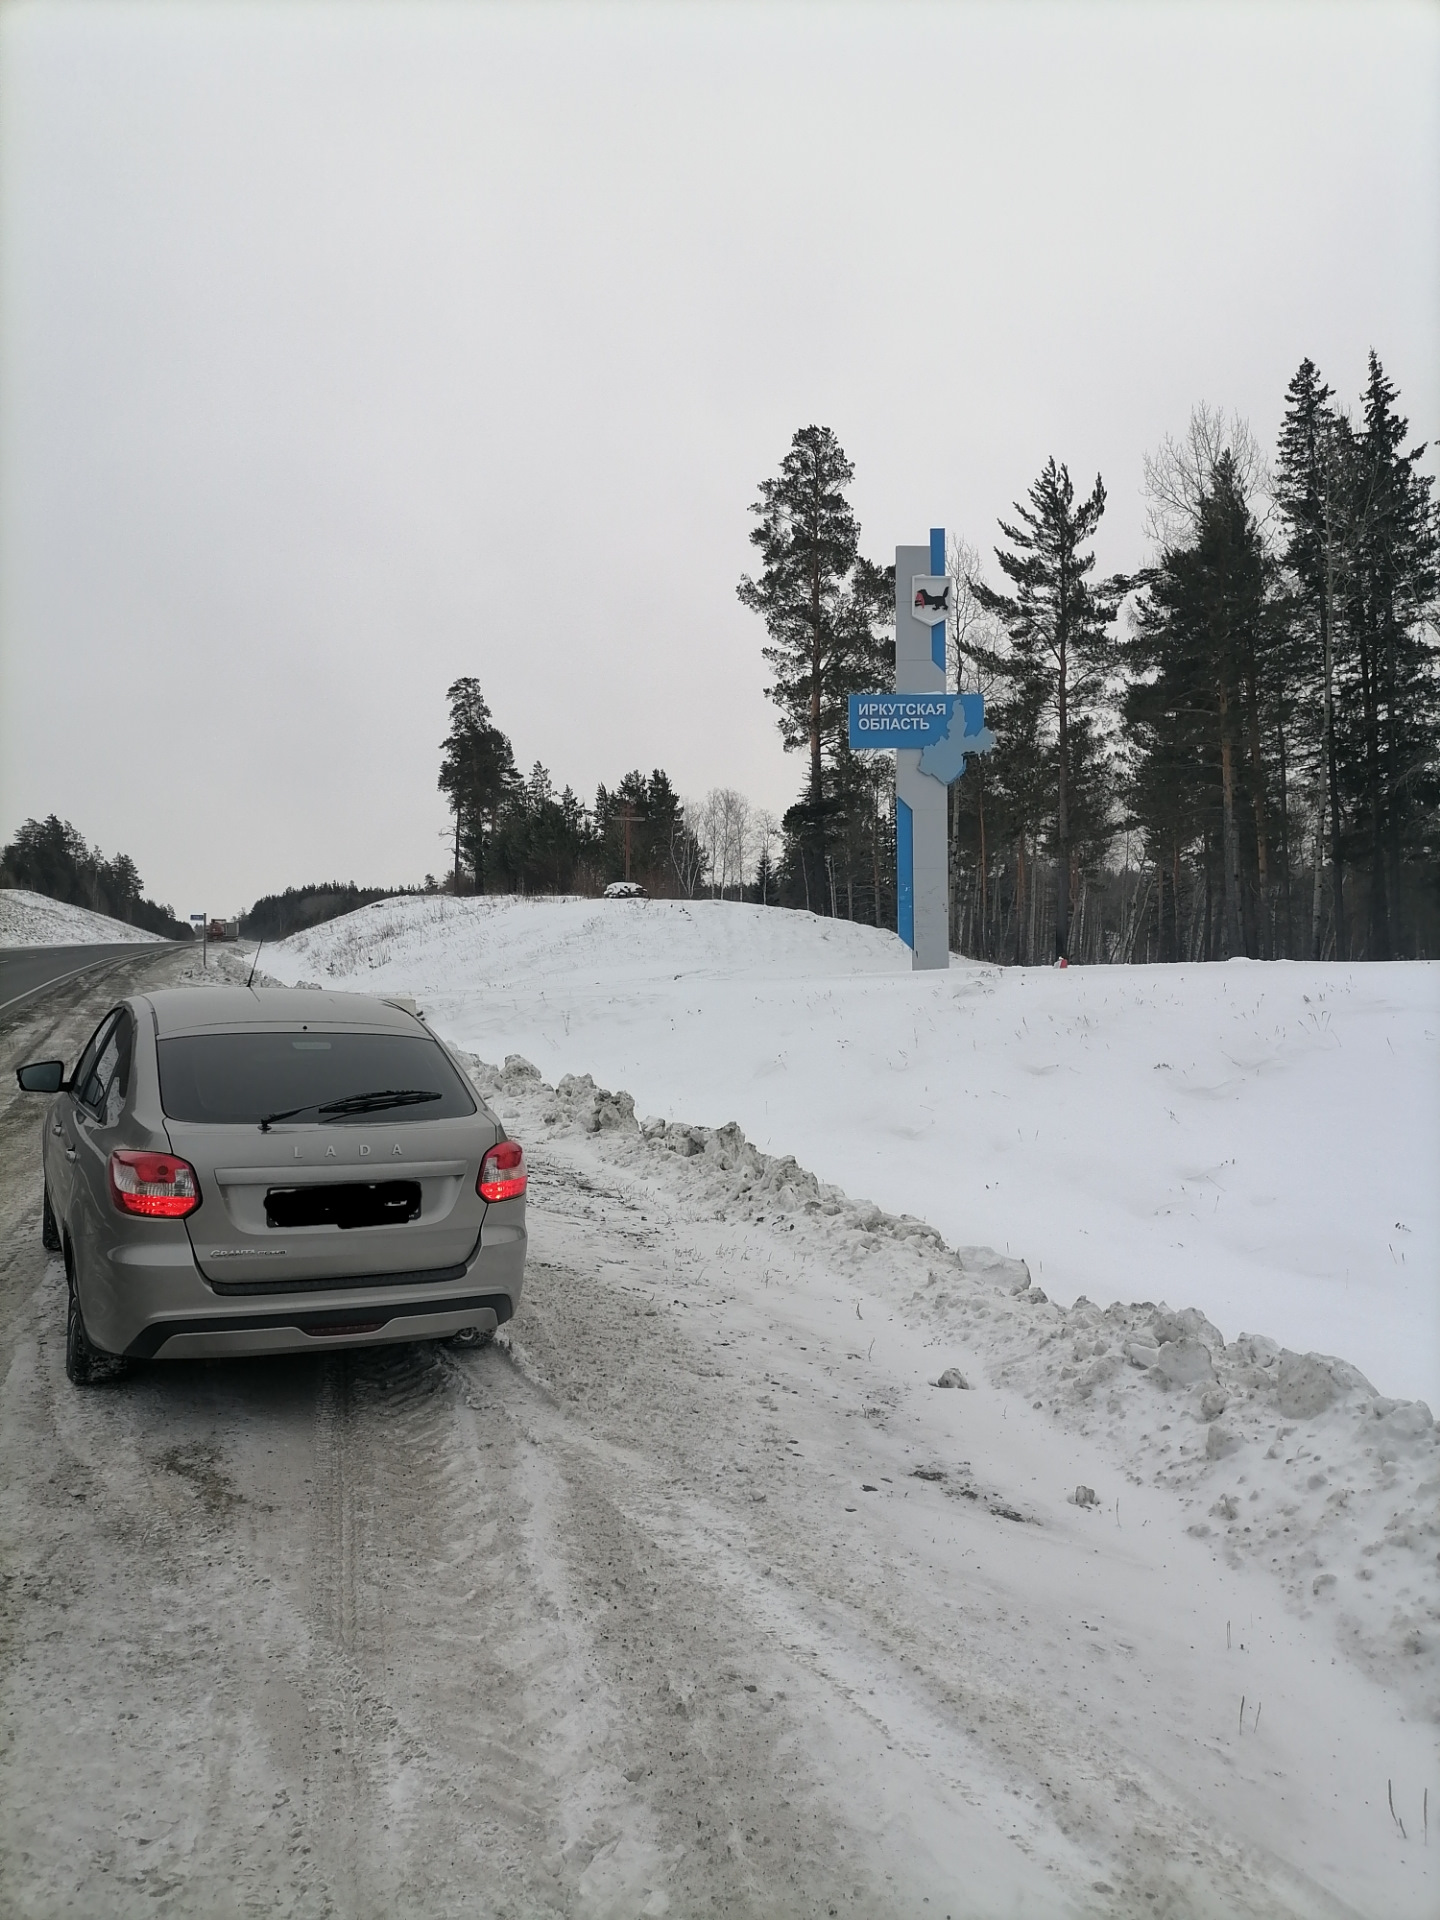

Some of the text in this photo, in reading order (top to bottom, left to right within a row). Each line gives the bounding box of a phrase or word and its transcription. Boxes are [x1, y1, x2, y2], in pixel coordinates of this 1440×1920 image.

[858, 703, 947, 716] ИРКУТСКАЯ
[858, 718, 930, 731] ОБЛАСТЬ
[292, 1143, 403, 1159] LADA
